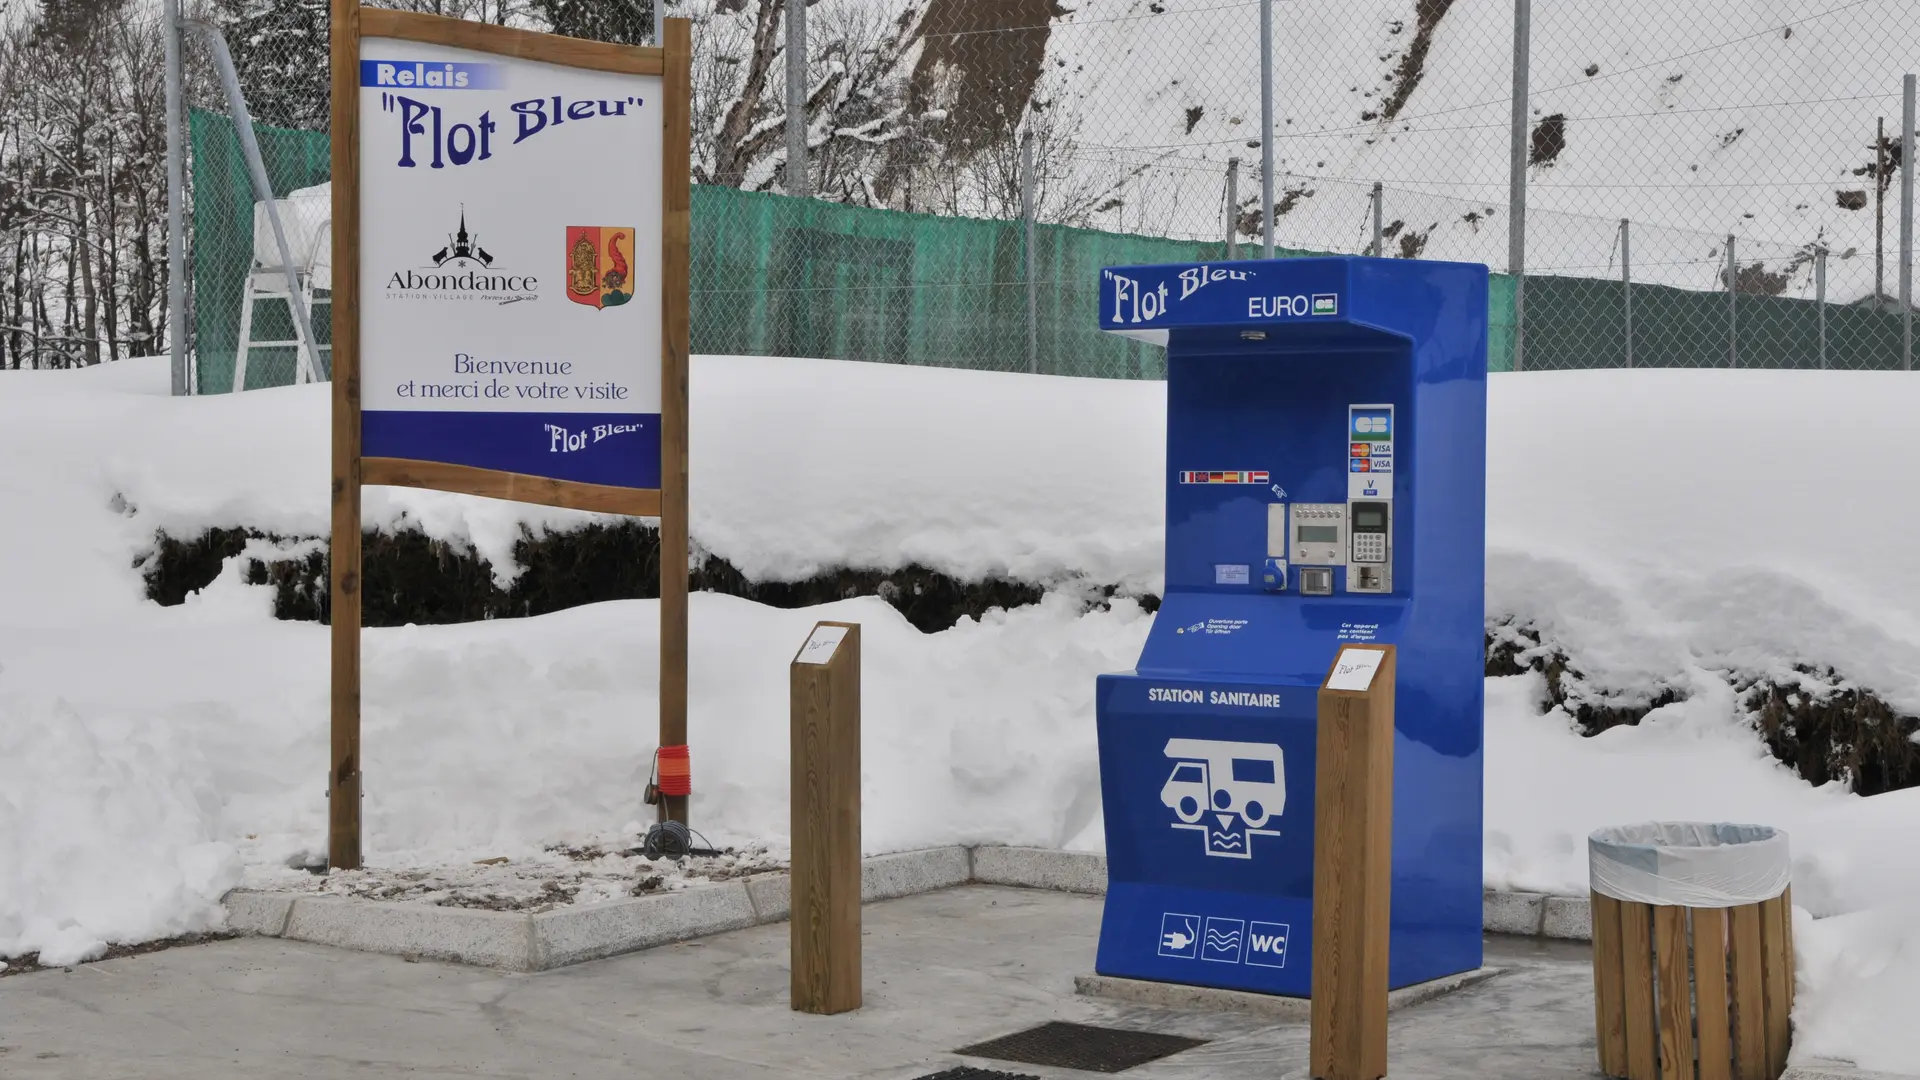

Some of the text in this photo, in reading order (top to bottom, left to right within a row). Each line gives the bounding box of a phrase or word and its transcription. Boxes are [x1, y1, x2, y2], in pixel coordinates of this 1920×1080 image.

[377, 63, 469, 88] Relais
[382, 92, 496, 169] "Flot
[386, 270, 538, 293] Abondance
[1248, 295, 1309, 318] EURO
[454, 353, 572, 376] Bienvenue
[396, 379, 629, 401] et merci de votre visite
[1373, 444, 1391, 453] VISA
[1373, 460, 1391, 468] VISA
[1148, 687, 1281, 708] STATION SANITAIRE
[1251, 933, 1285, 954] WC
